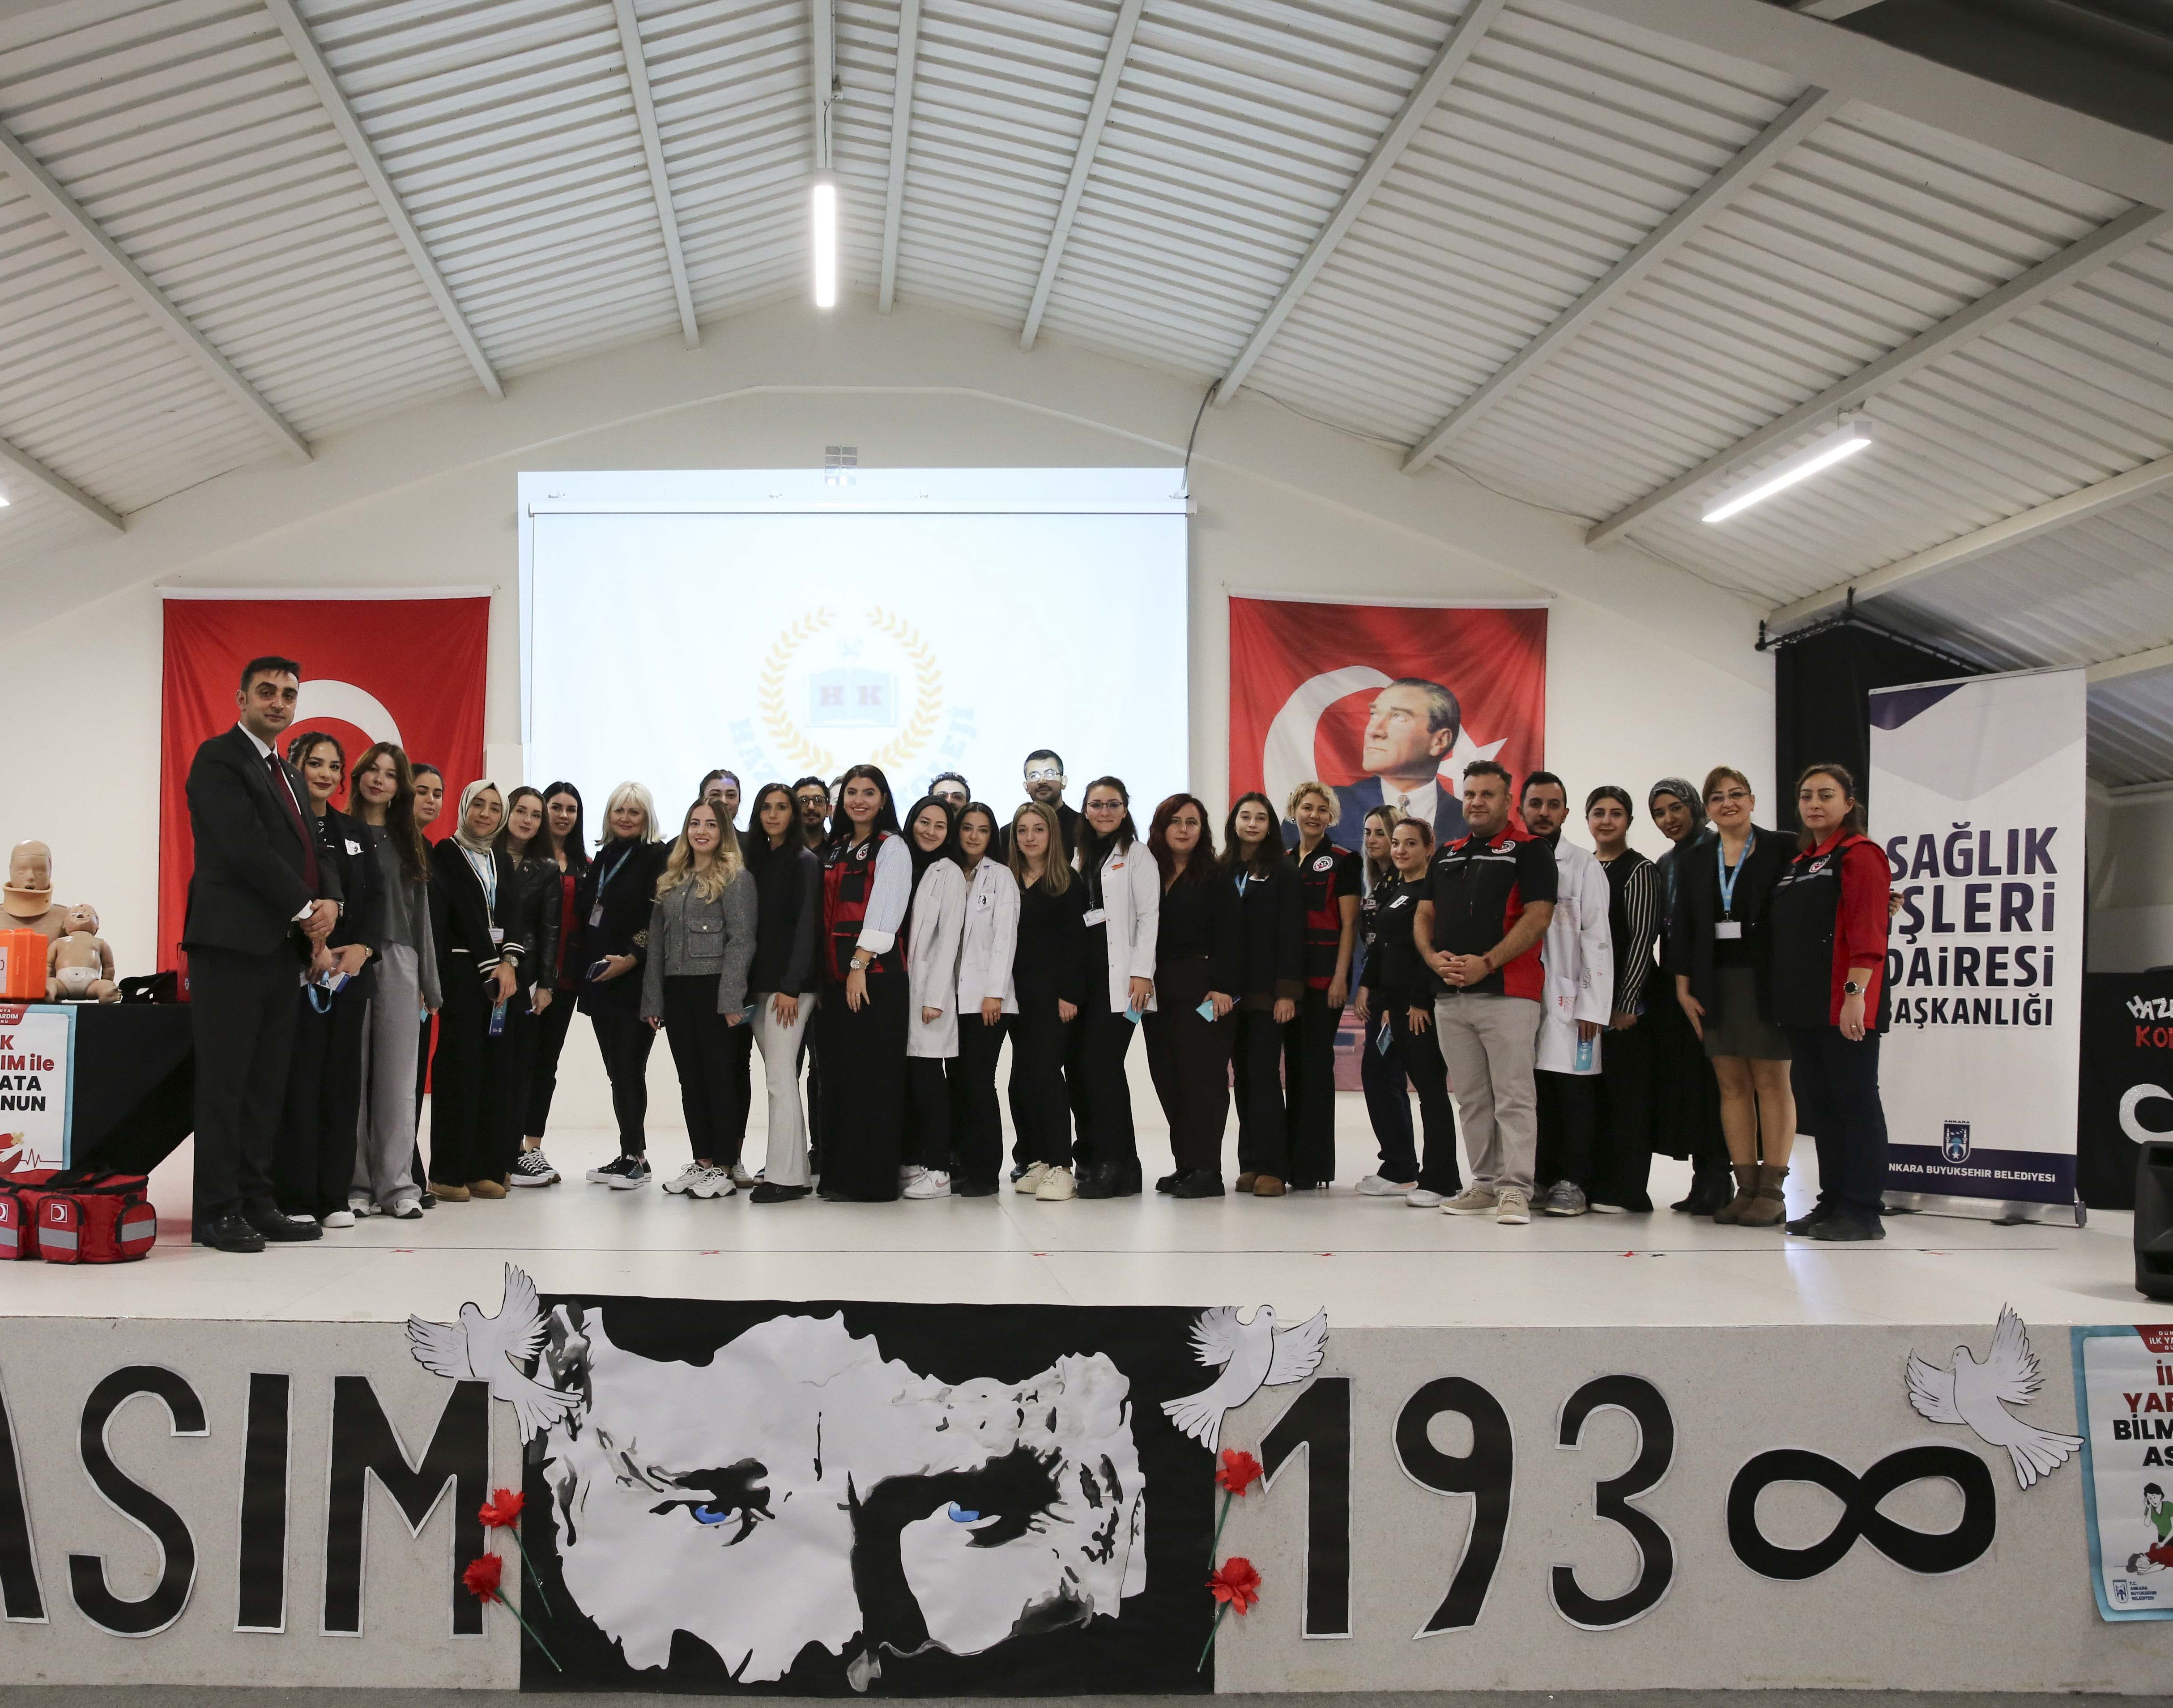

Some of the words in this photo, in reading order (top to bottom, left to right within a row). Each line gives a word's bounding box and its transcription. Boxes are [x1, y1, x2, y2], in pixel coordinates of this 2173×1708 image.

[1886, 821, 2058, 882] SAĞLIK
[1890, 993, 2052, 1029] AŞKANLIĞI
[2126, 995, 2173, 1021] HAZ
[30, 1053, 54, 1071] ile
[1888, 1163, 1924, 1173] NKARA
